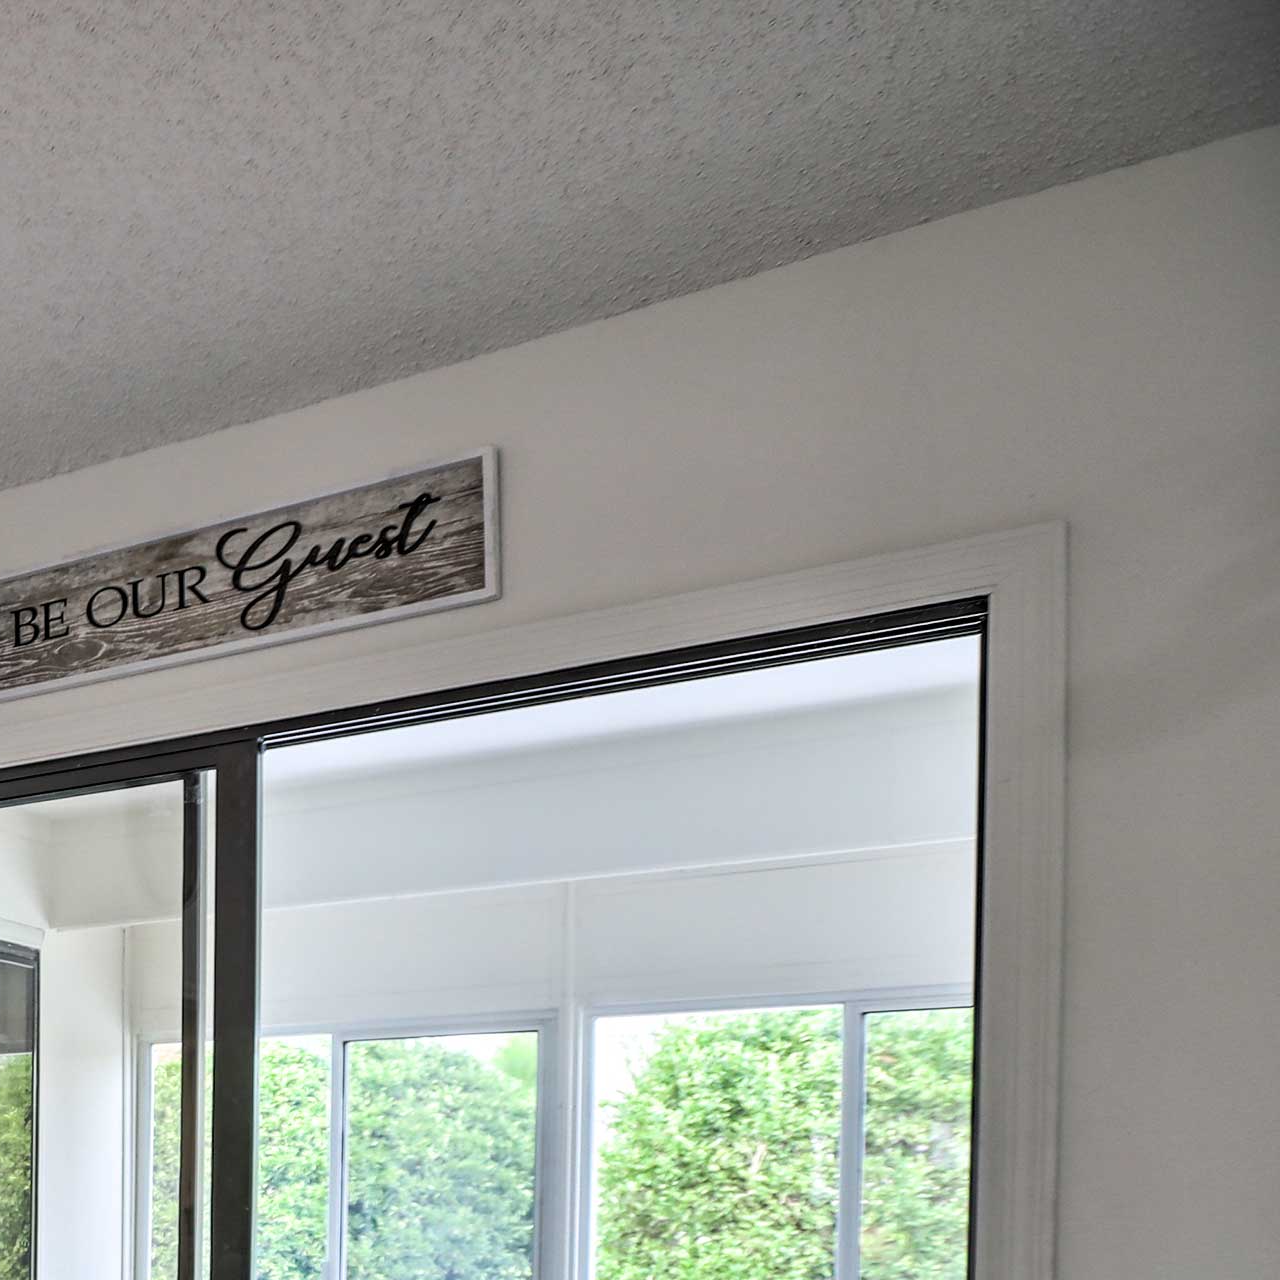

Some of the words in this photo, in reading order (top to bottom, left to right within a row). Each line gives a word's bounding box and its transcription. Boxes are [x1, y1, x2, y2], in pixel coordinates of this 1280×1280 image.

[11, 599, 70, 648] BE
[85, 564, 210, 628] OUR
[215, 493, 440, 631] Guest
